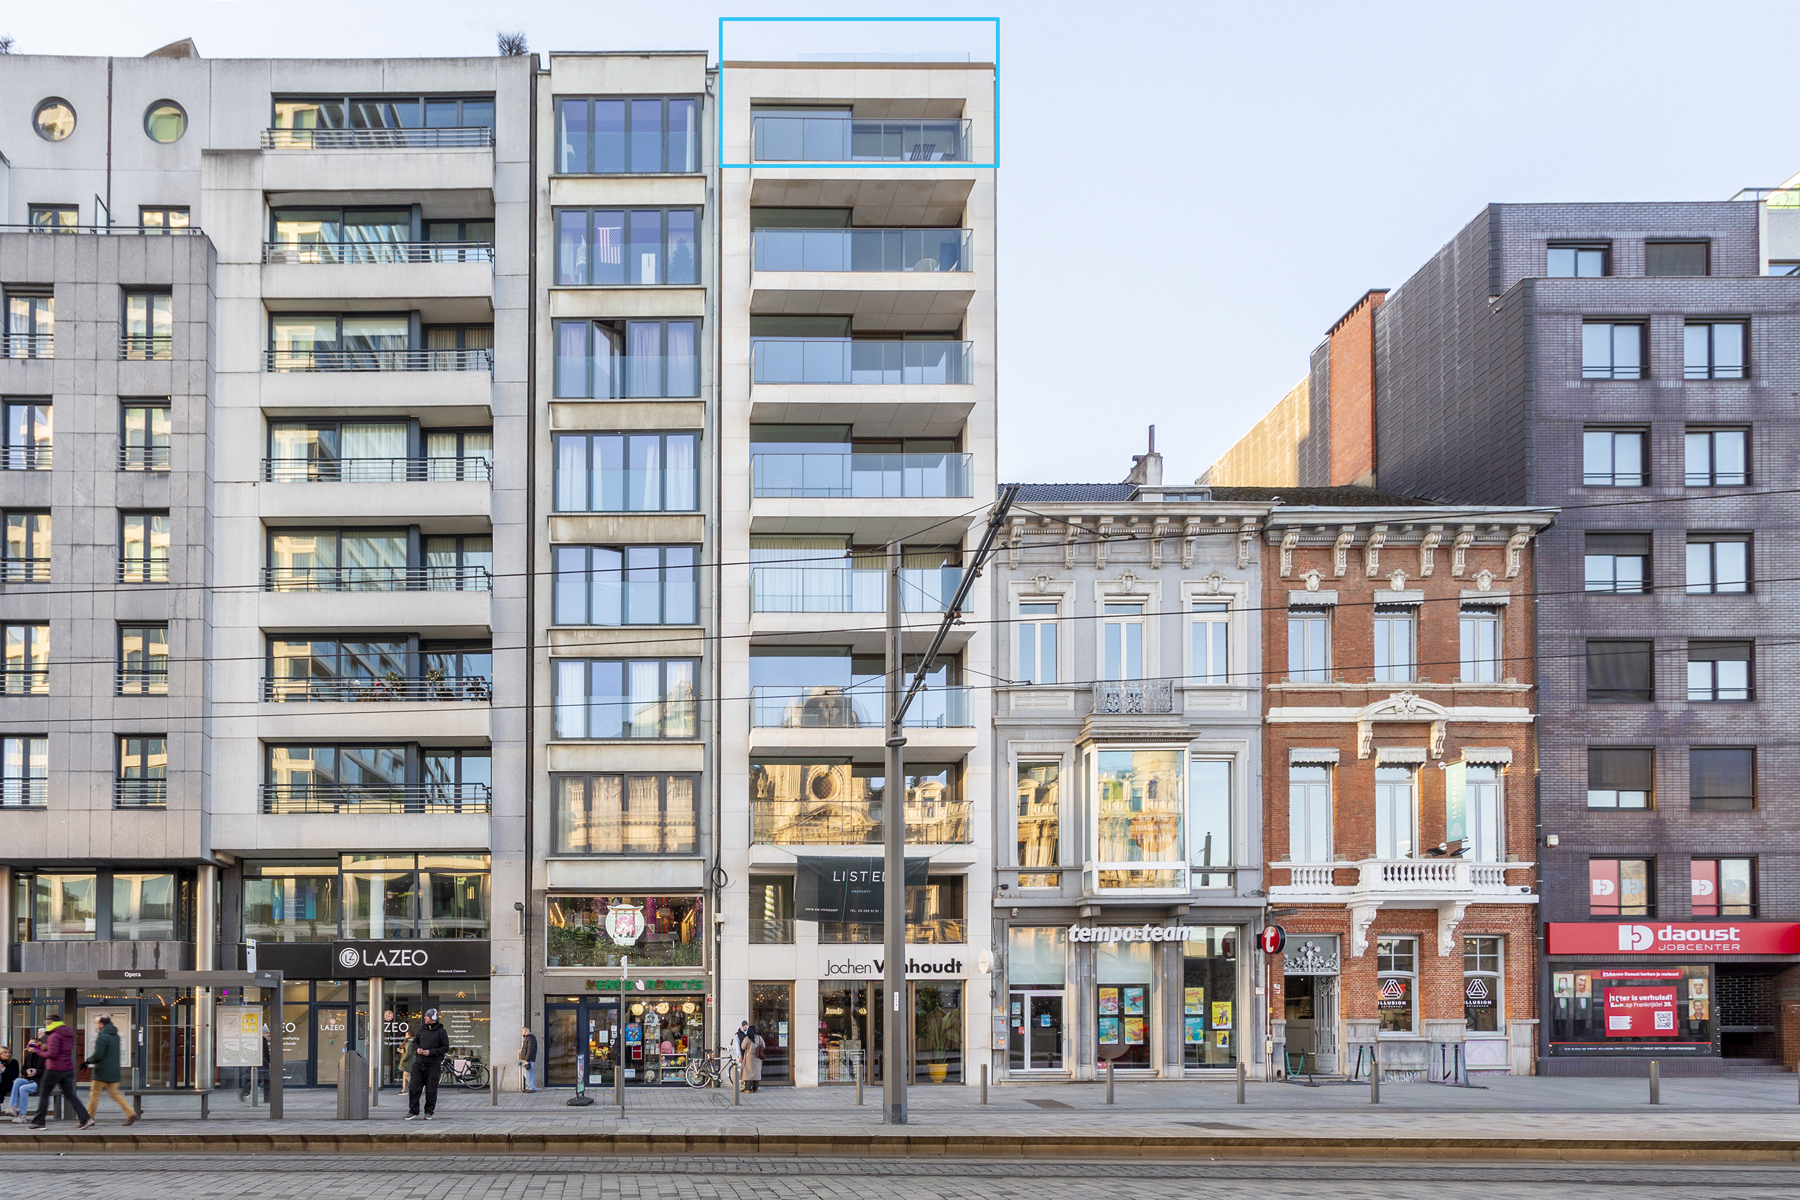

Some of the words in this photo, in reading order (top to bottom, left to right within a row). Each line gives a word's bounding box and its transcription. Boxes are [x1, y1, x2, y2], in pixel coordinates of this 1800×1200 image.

[1263, 928, 1276, 954] t
[1657, 925, 1741, 941] daoust
[1657, 943, 1741, 951] JOBCENTER
[362, 949, 429, 967] LAZEO
[124, 971, 142, 979] Opera
[824, 958, 872, 977] Jochen
[873, 957, 963, 974] Vhoudt
[646, 978, 703, 991] ADDICTS
